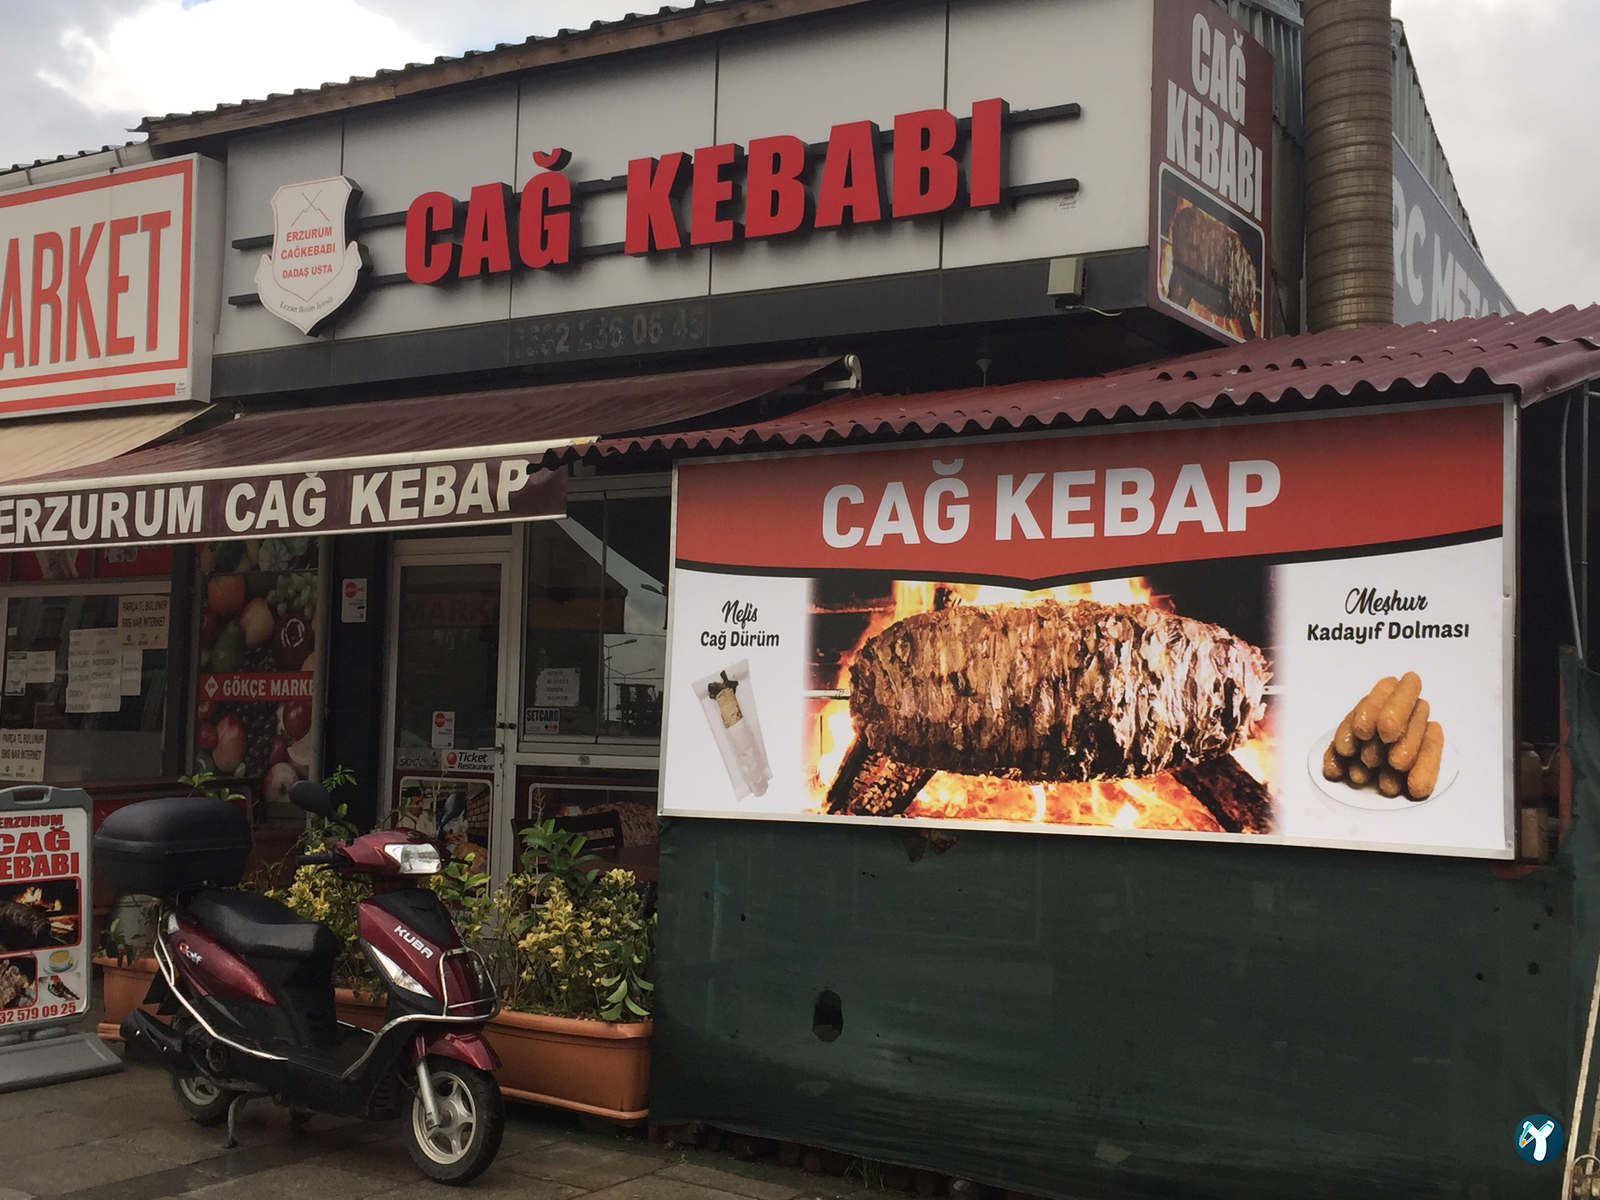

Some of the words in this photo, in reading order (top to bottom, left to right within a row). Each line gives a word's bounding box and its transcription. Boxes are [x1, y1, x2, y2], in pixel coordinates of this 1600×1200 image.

[1191, 13, 1246, 126] CAĞ
[1167, 79, 1263, 221] KEBABI
[405, 148, 572, 285] CAĞ
[625, 98, 1003, 257] KEBABI
[286, 226, 333, 242] ERZURUM
[281, 243, 336, 260] CAĞKEBABI
[282, 268, 309, 279] DADAŞ
[311, 264, 333, 275] USTA
[0, 210, 171, 370] ARKET
[632, 311, 663, 345] 06
[0, 485, 203, 544] ERZURUM
[225, 473, 326, 533] CAĞ
[350, 460, 530, 525] KEBAP
[821, 458, 971, 549] CAĞ
[995, 459, 1281, 542] KEBAP
[722, 600, 758, 629] Nefis
[1345, 587, 1428, 615] Meşhur
[701, 630, 726, 650] Cağ
[731, 630, 779, 647] Dürüm
[1307, 622, 1384, 644] Kadayıf
[1388, 621, 1469, 640] Dolması
[223, 676, 266, 698] GÖKÇE
[527, 710, 559, 721] SETCARD
[459, 752, 488, 763] Ticket
[0, 826, 70, 855] CAĞ
[0, 852, 79, 879] EBABI
[394, 925, 434, 959] KUBA
[17, 1007, 39, 1021] 579
[42, 1004, 58, 1017] 09
[61, 1002, 76, 1014] 25
